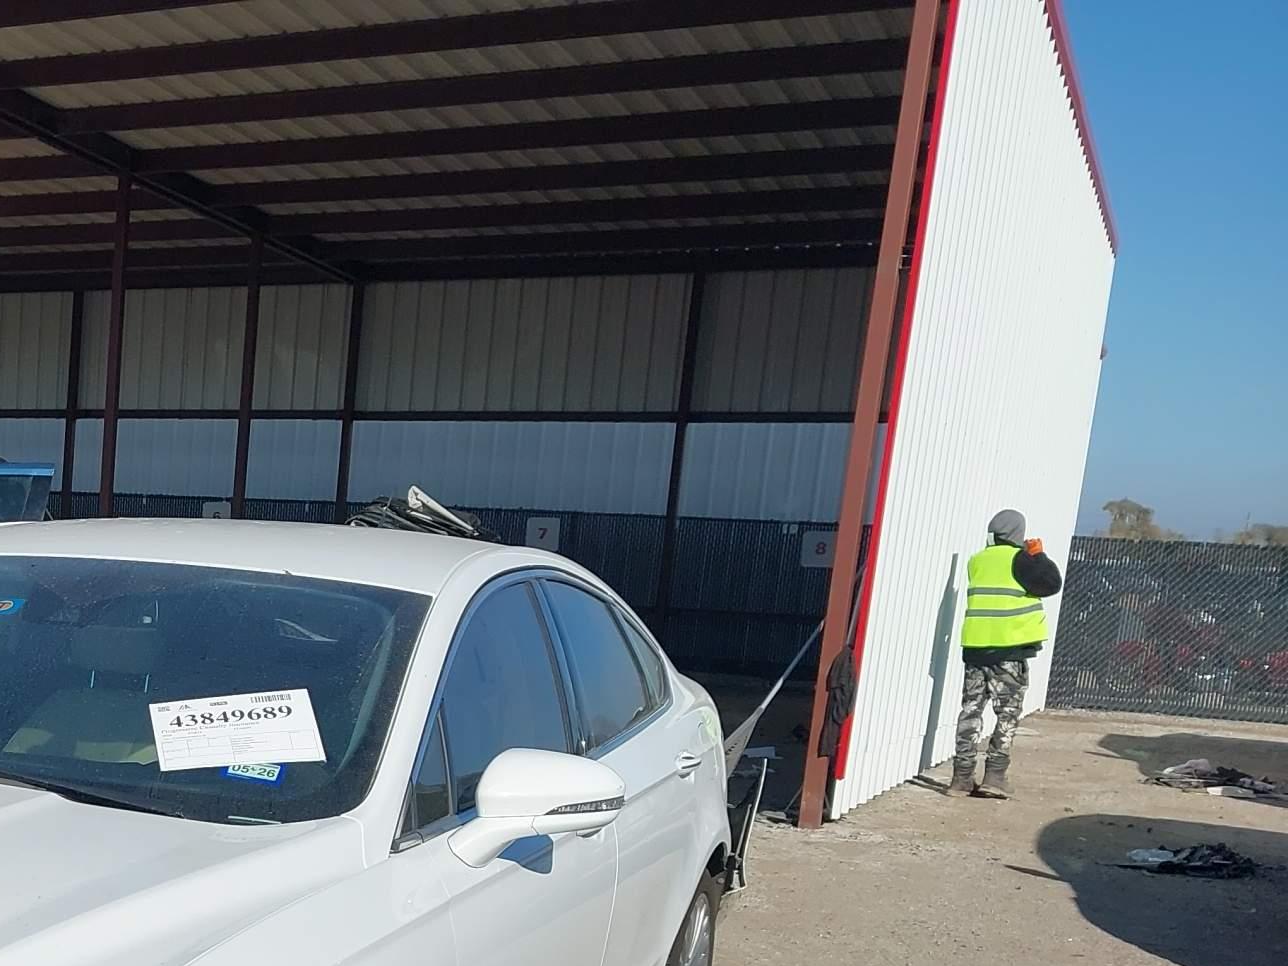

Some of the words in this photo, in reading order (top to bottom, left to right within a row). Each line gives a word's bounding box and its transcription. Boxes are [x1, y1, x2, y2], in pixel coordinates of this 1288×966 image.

[537, 527, 549, 540] 7
[815, 541, 827, 555] 8
[169, 705, 293, 727] 43849689
[257, 767, 276, 778] 26
